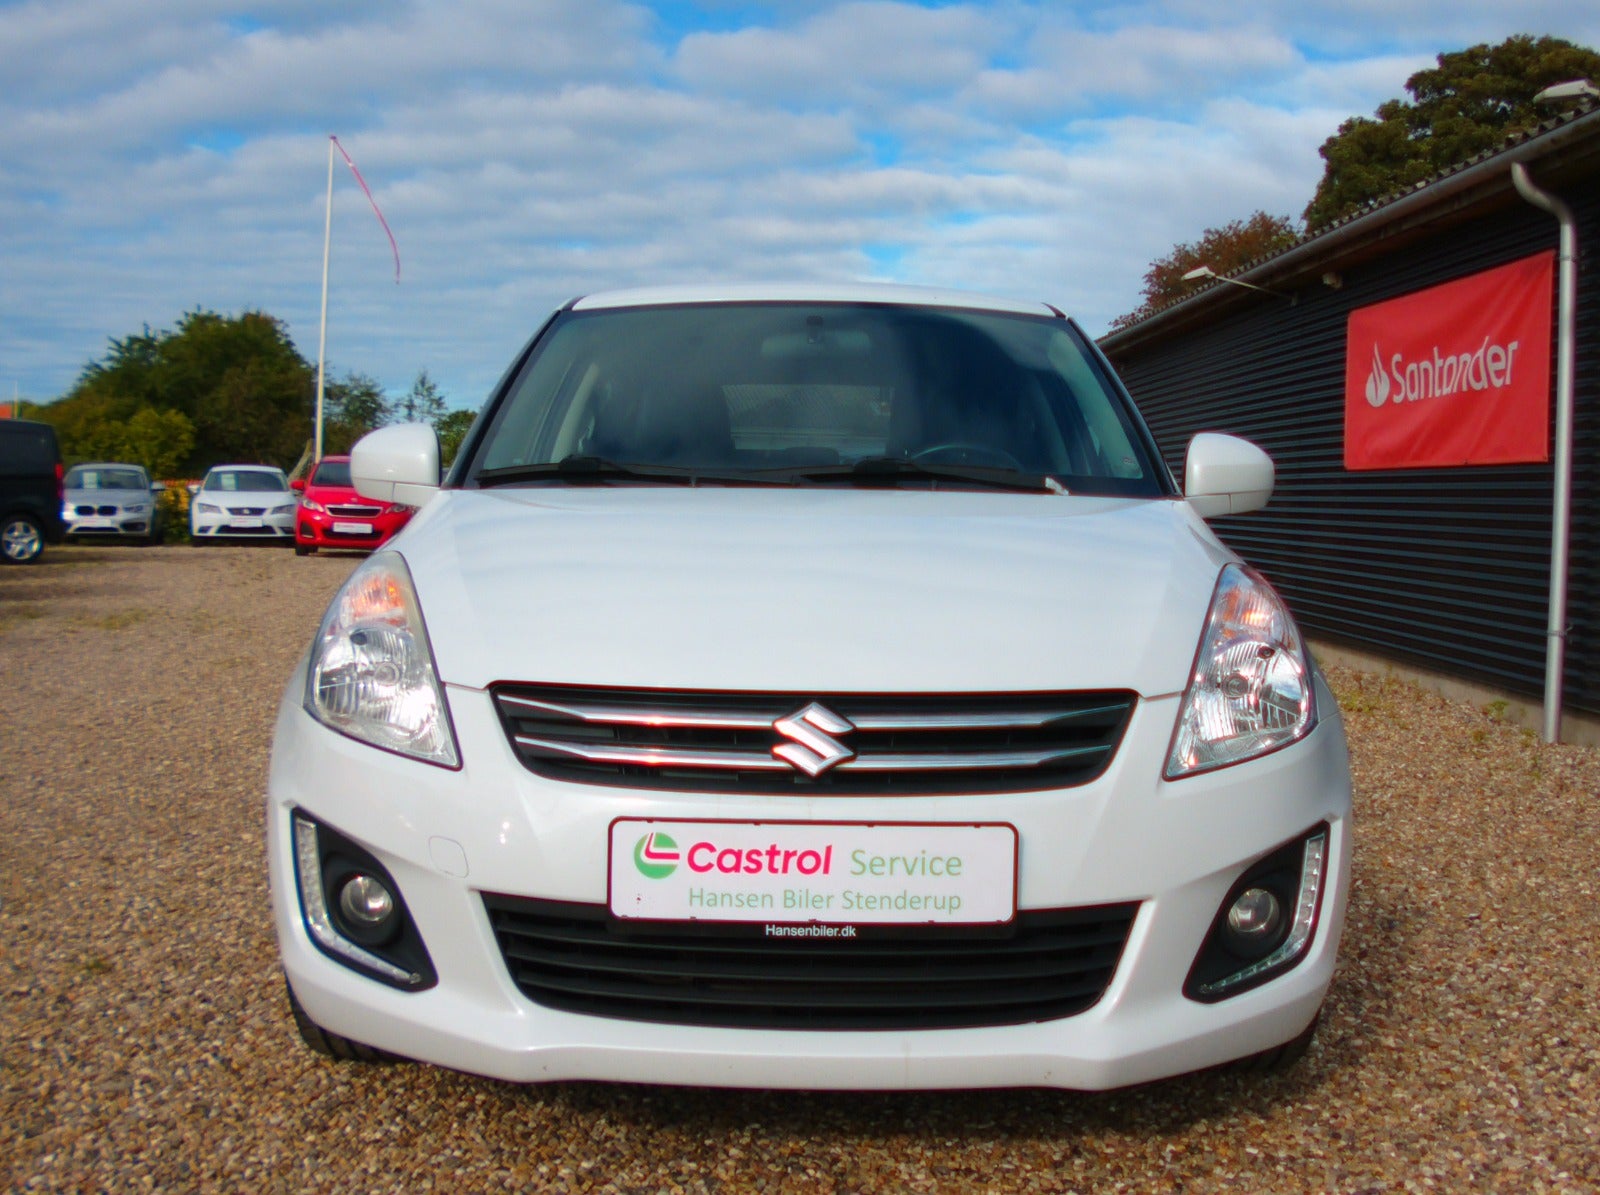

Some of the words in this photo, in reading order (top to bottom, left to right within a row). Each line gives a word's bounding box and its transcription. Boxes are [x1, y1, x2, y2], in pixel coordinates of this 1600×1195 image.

[1391, 336, 1518, 404] Santander
[687, 842, 833, 875] Castrol
[850, 849, 962, 876] Service
[689, 887, 774, 909] Hansen
[783, 889, 834, 910] Biler
[842, 890, 961, 915] Stenderup
[765, 924, 856, 938] Hansenbiler.dk
